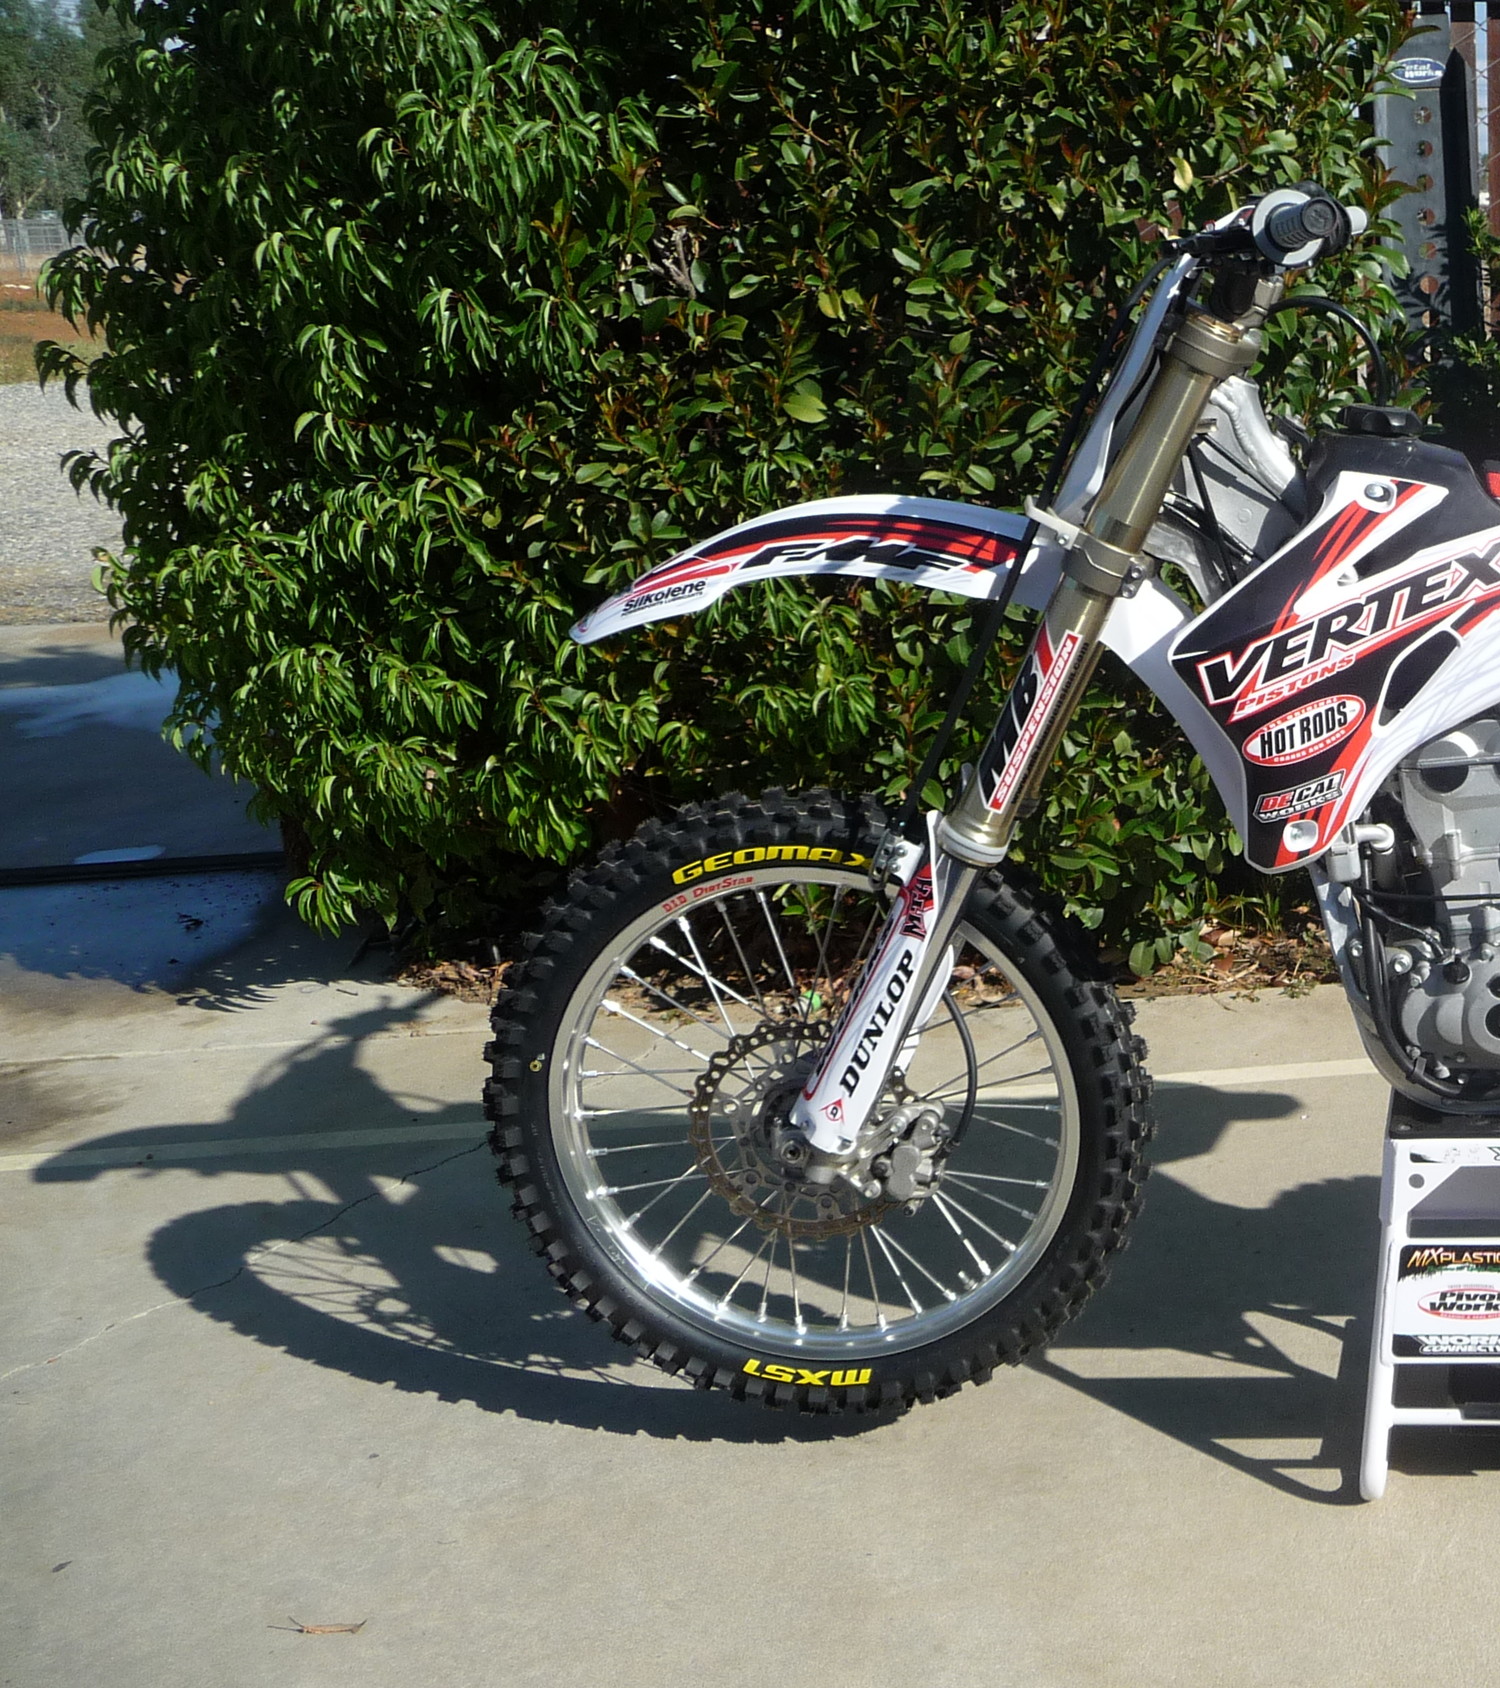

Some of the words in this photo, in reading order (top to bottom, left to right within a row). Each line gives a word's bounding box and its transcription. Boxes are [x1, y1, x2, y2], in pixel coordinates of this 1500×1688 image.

[739, 538, 968, 571] FMF
[622, 580, 706, 612] Silkolene
[1235, 653, 1355, 714] PISTONS
[998, 638, 1075, 804] SUSPENSION
[1260, 723, 1296, 760] HOT
[1298, 700, 1349, 745] RODS
[1258, 790, 1341, 820] WORKS
[1260, 777, 1338, 812] DECAL
[671, 845, 873, 885] GEOMAX
[839, 949, 914, 1098] DUNLOP
[742, 1358, 873, 1386] MX51
